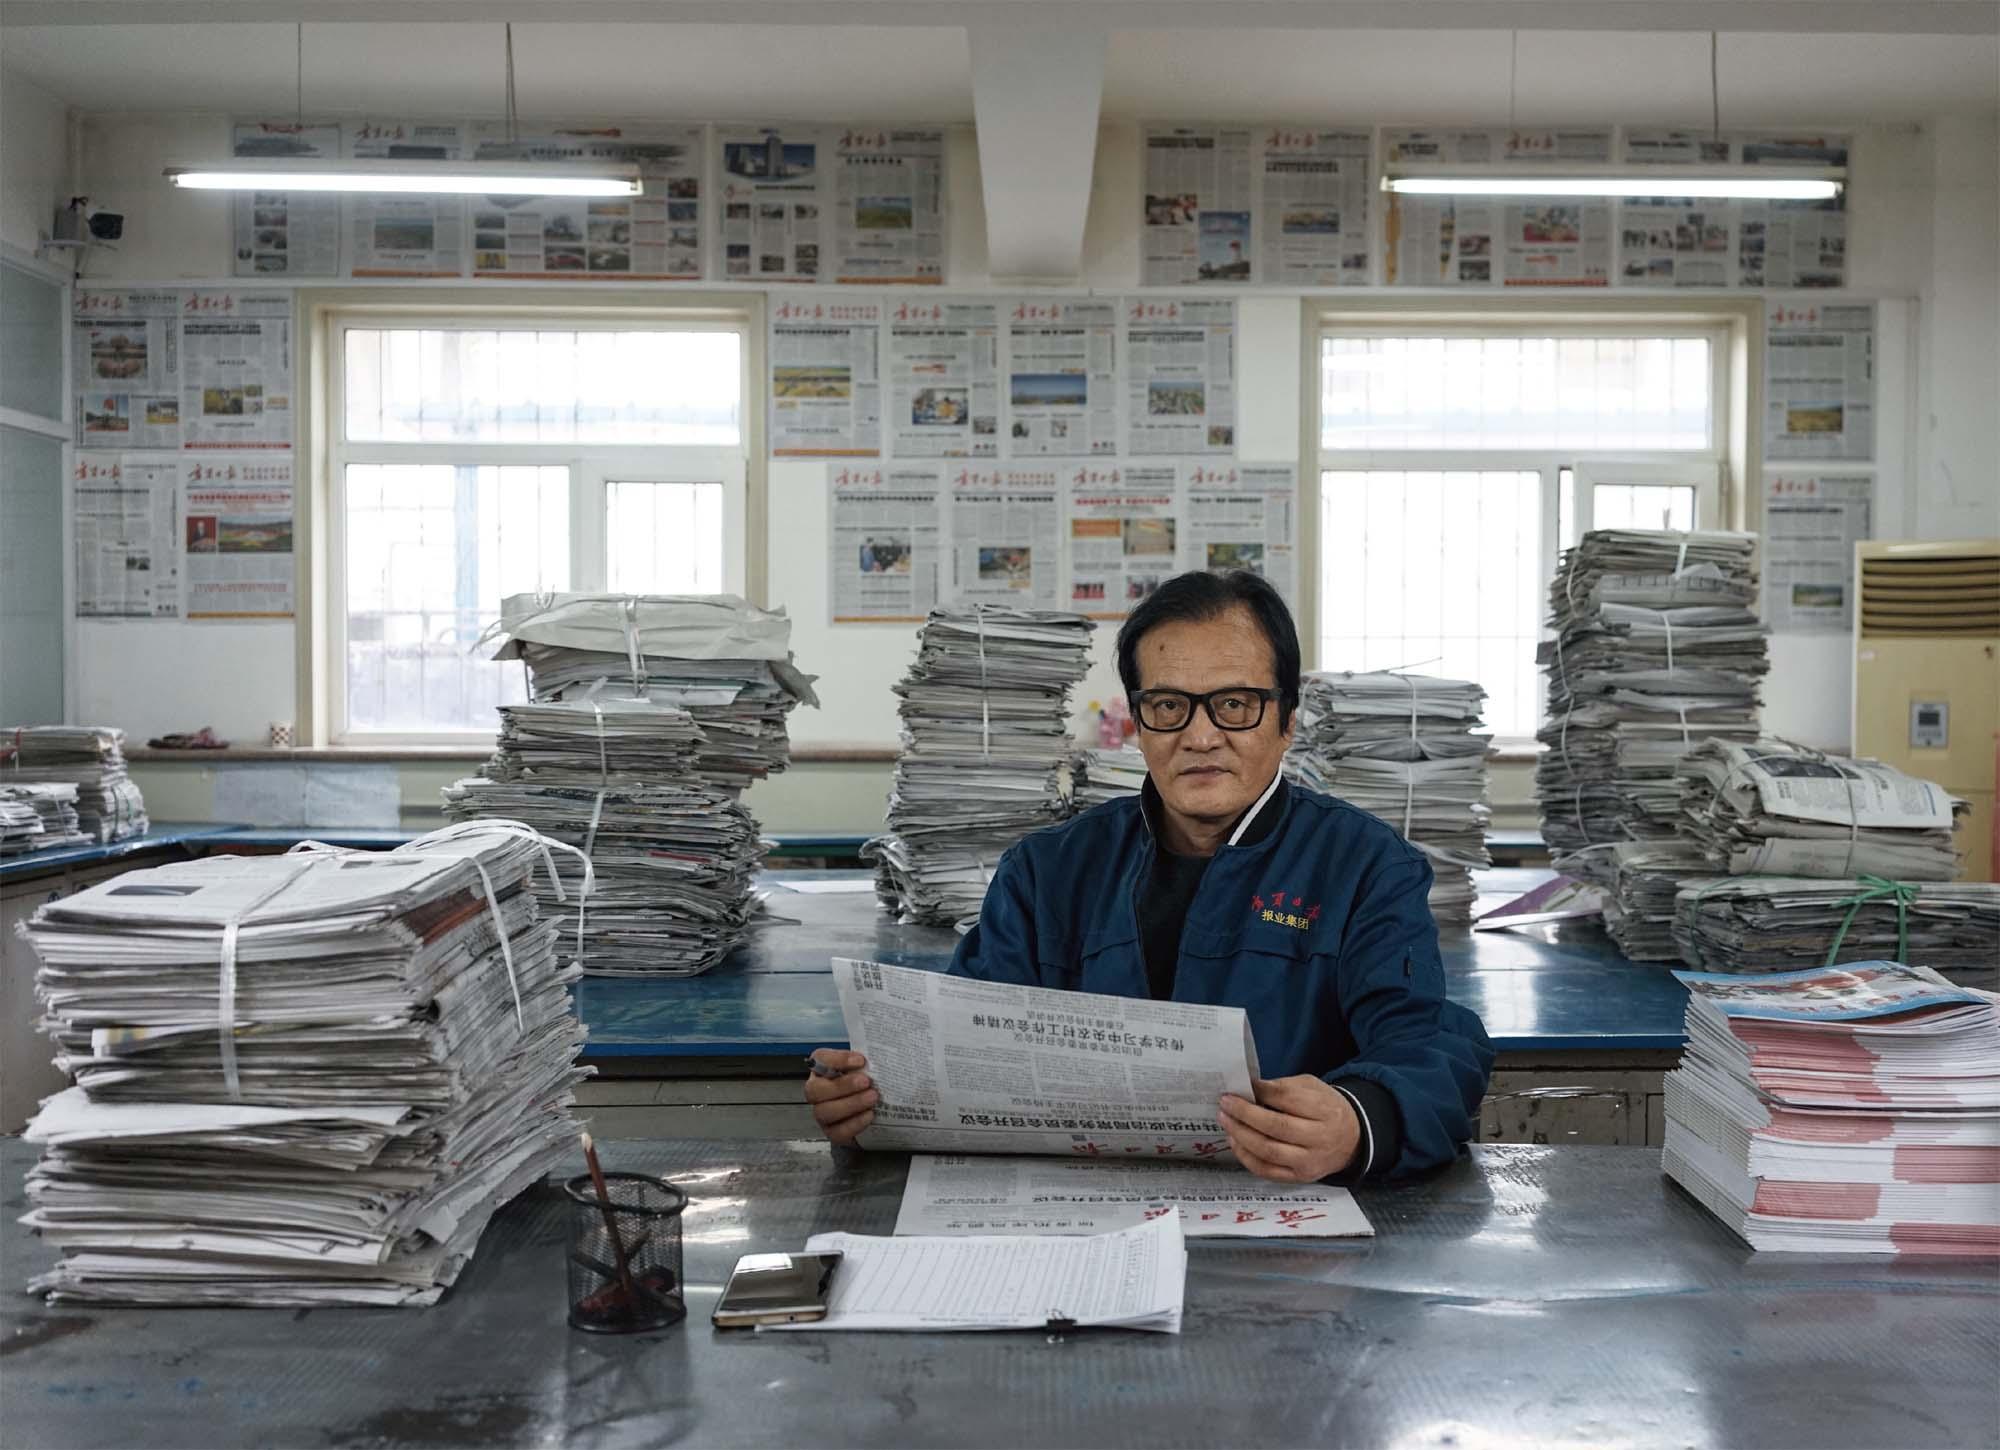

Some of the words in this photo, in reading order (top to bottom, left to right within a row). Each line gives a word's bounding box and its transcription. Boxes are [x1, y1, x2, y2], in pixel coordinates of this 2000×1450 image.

[1262, 909, 1308, 929] 报业集团
[972, 1015, 1185, 1051] 传达学习中央农村工作会议精神
[959, 1112, 1225, 1135] 共中央政治局常务委员会召开会议
